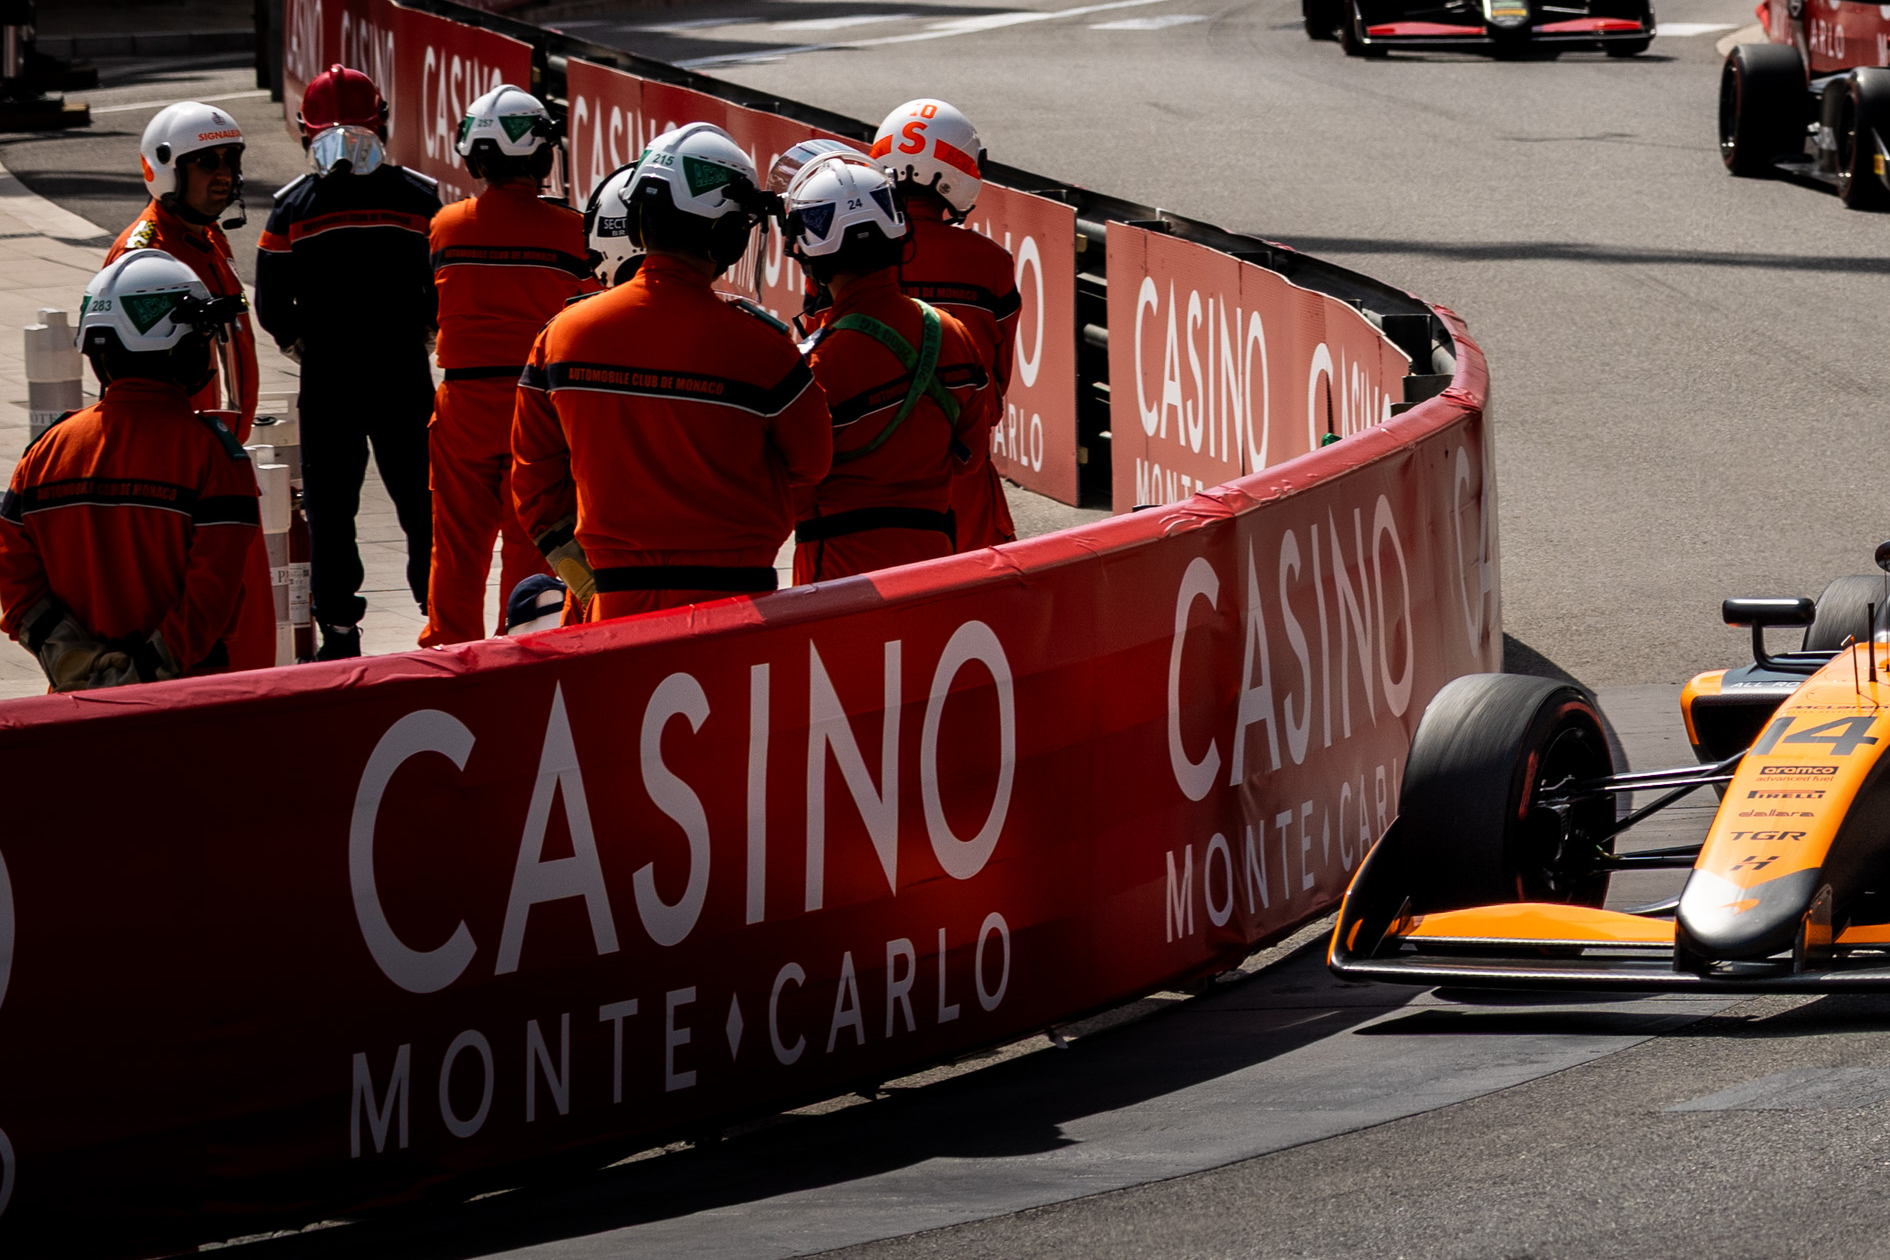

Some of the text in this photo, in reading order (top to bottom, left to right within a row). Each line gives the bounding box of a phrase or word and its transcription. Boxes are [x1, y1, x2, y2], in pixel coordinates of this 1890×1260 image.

[1810, 18, 1845, 61] ARLO
[423, 45, 503, 170] CAS
[572, 95, 679, 215] CAS
[898, 120, 929, 155] S
[653, 153, 675, 167] 215
[847, 198, 863, 211] 24
[603, 218, 628, 231] SECT
[92, 300, 113, 312] 283
[568, 367, 725, 396] AUTOMOBILE CLUB DE MONACO
[1134, 276, 1270, 474] CASINO
[1308, 341, 1392, 452] CASIN
[993, 412, 1044, 474] ARLO
[37, 480, 178, 503] AUTOMOBILE CLUB DE MONACO
[1136, 457, 1206, 508] MON
[1168, 494, 1414, 802] CASINO
[1730, 681, 1802, 689] ALL RO
[1787, 702, 1890, 711] McLaren
[1749, 716, 1880, 756] 14
[1763, 766, 1836, 775] aramco
[349, 620, 1016, 994] CASINO
[1738, 808, 1815, 817] dallara
[1747, 790, 1827, 800] PIRELLI
[1730, 830, 1807, 842] TGR
[1166, 800, 1315, 944] MONTE
[350, 911, 1011, 1159] MONTE CARLO
